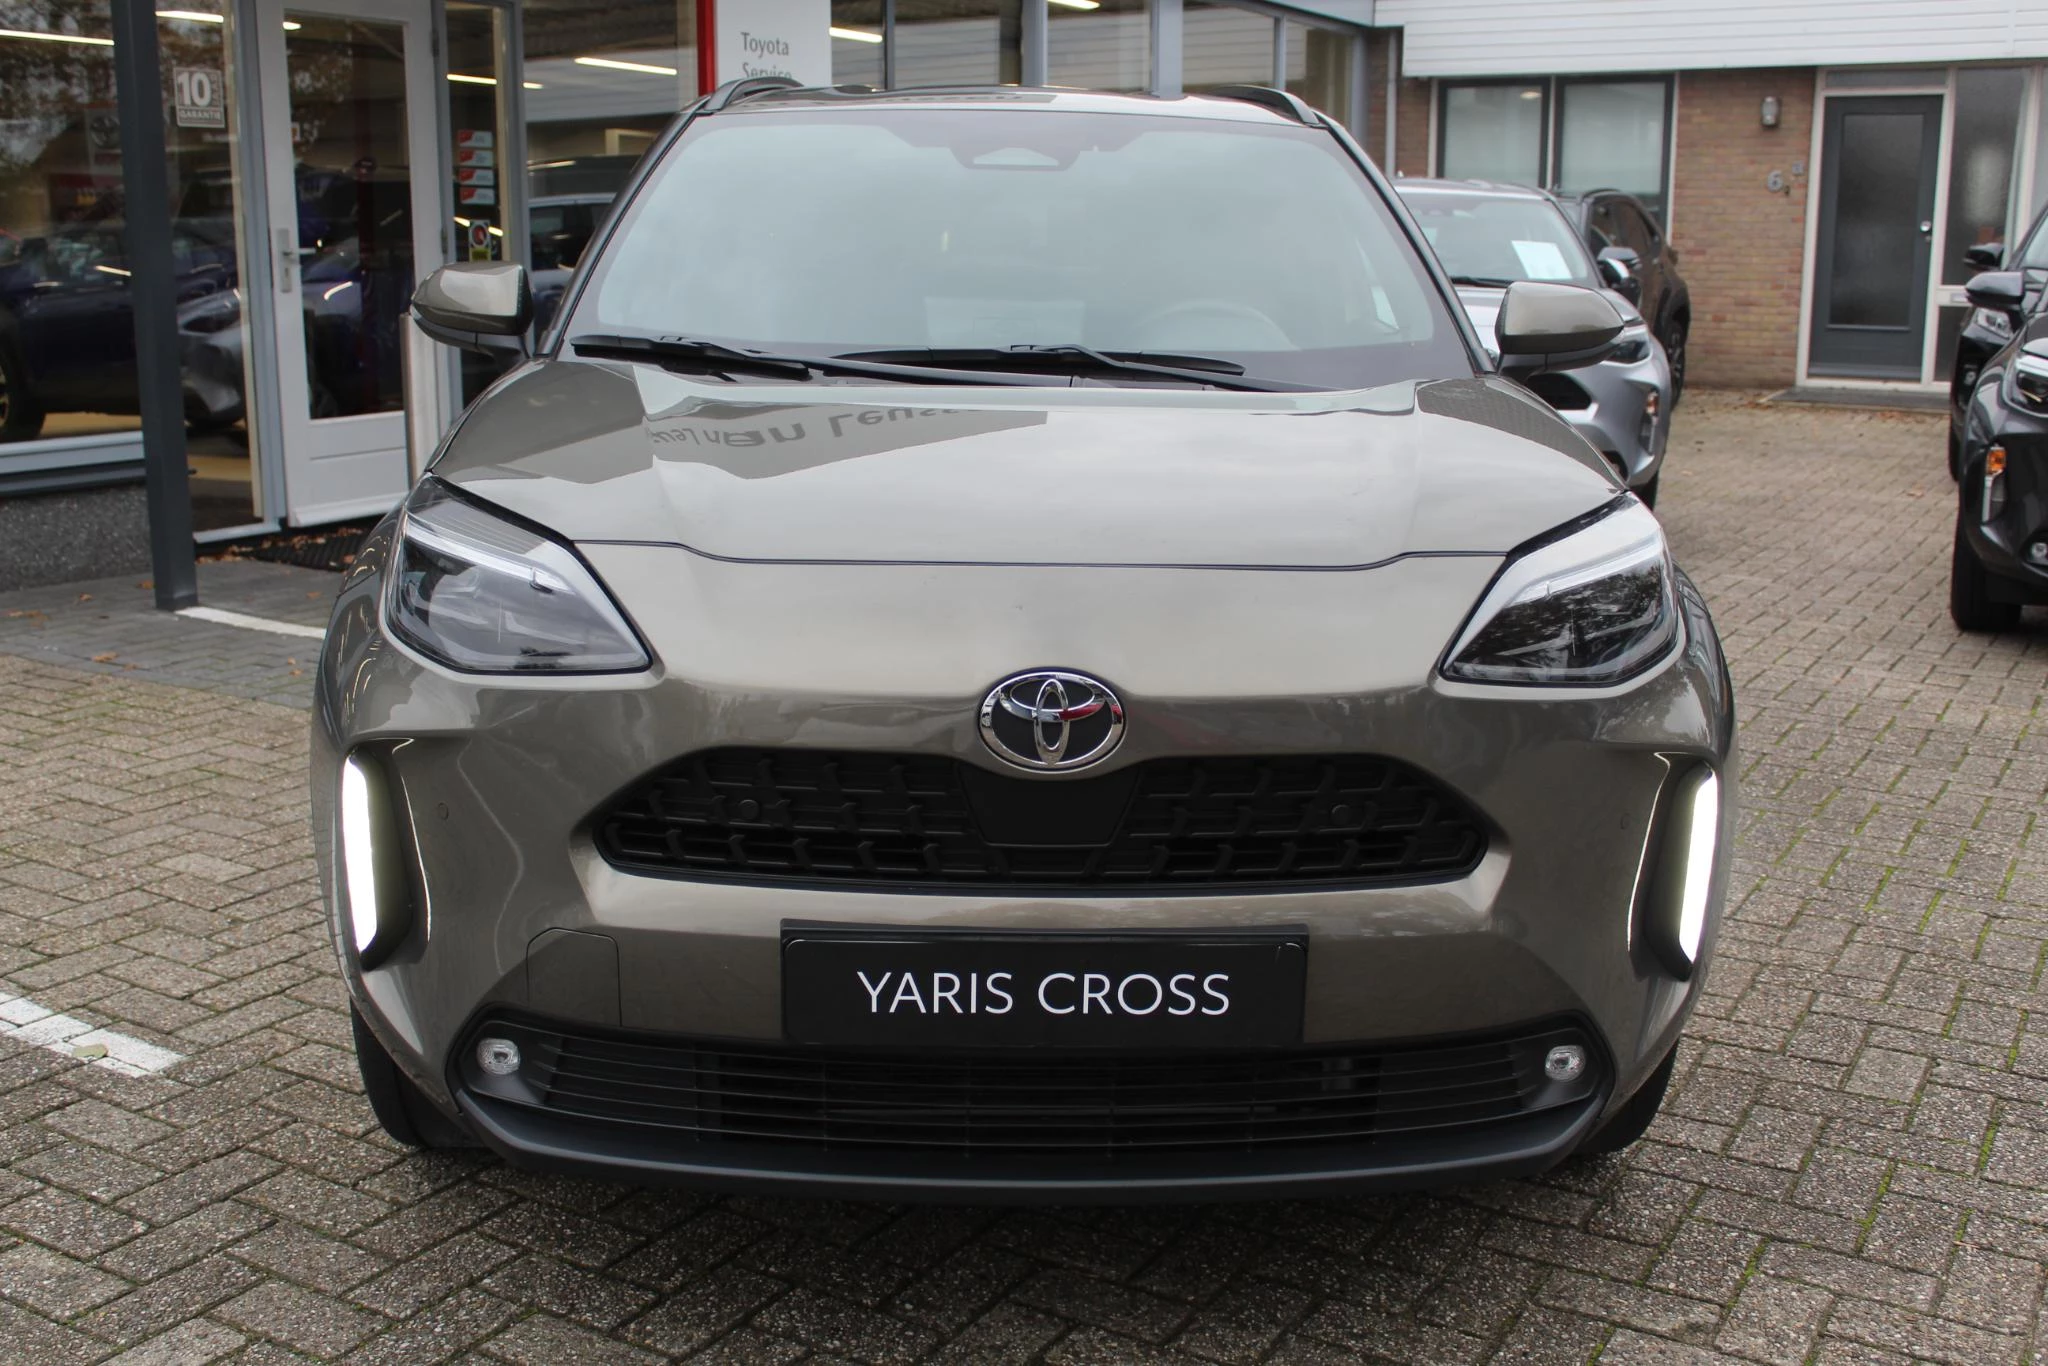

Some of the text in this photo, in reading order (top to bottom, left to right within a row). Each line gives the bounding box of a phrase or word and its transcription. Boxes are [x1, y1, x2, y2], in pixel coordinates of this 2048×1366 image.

[740, 31, 789, 58] Toyota
[178, 72, 210, 107] 10
[856, 970, 1230, 1016] YARIS CROSS
